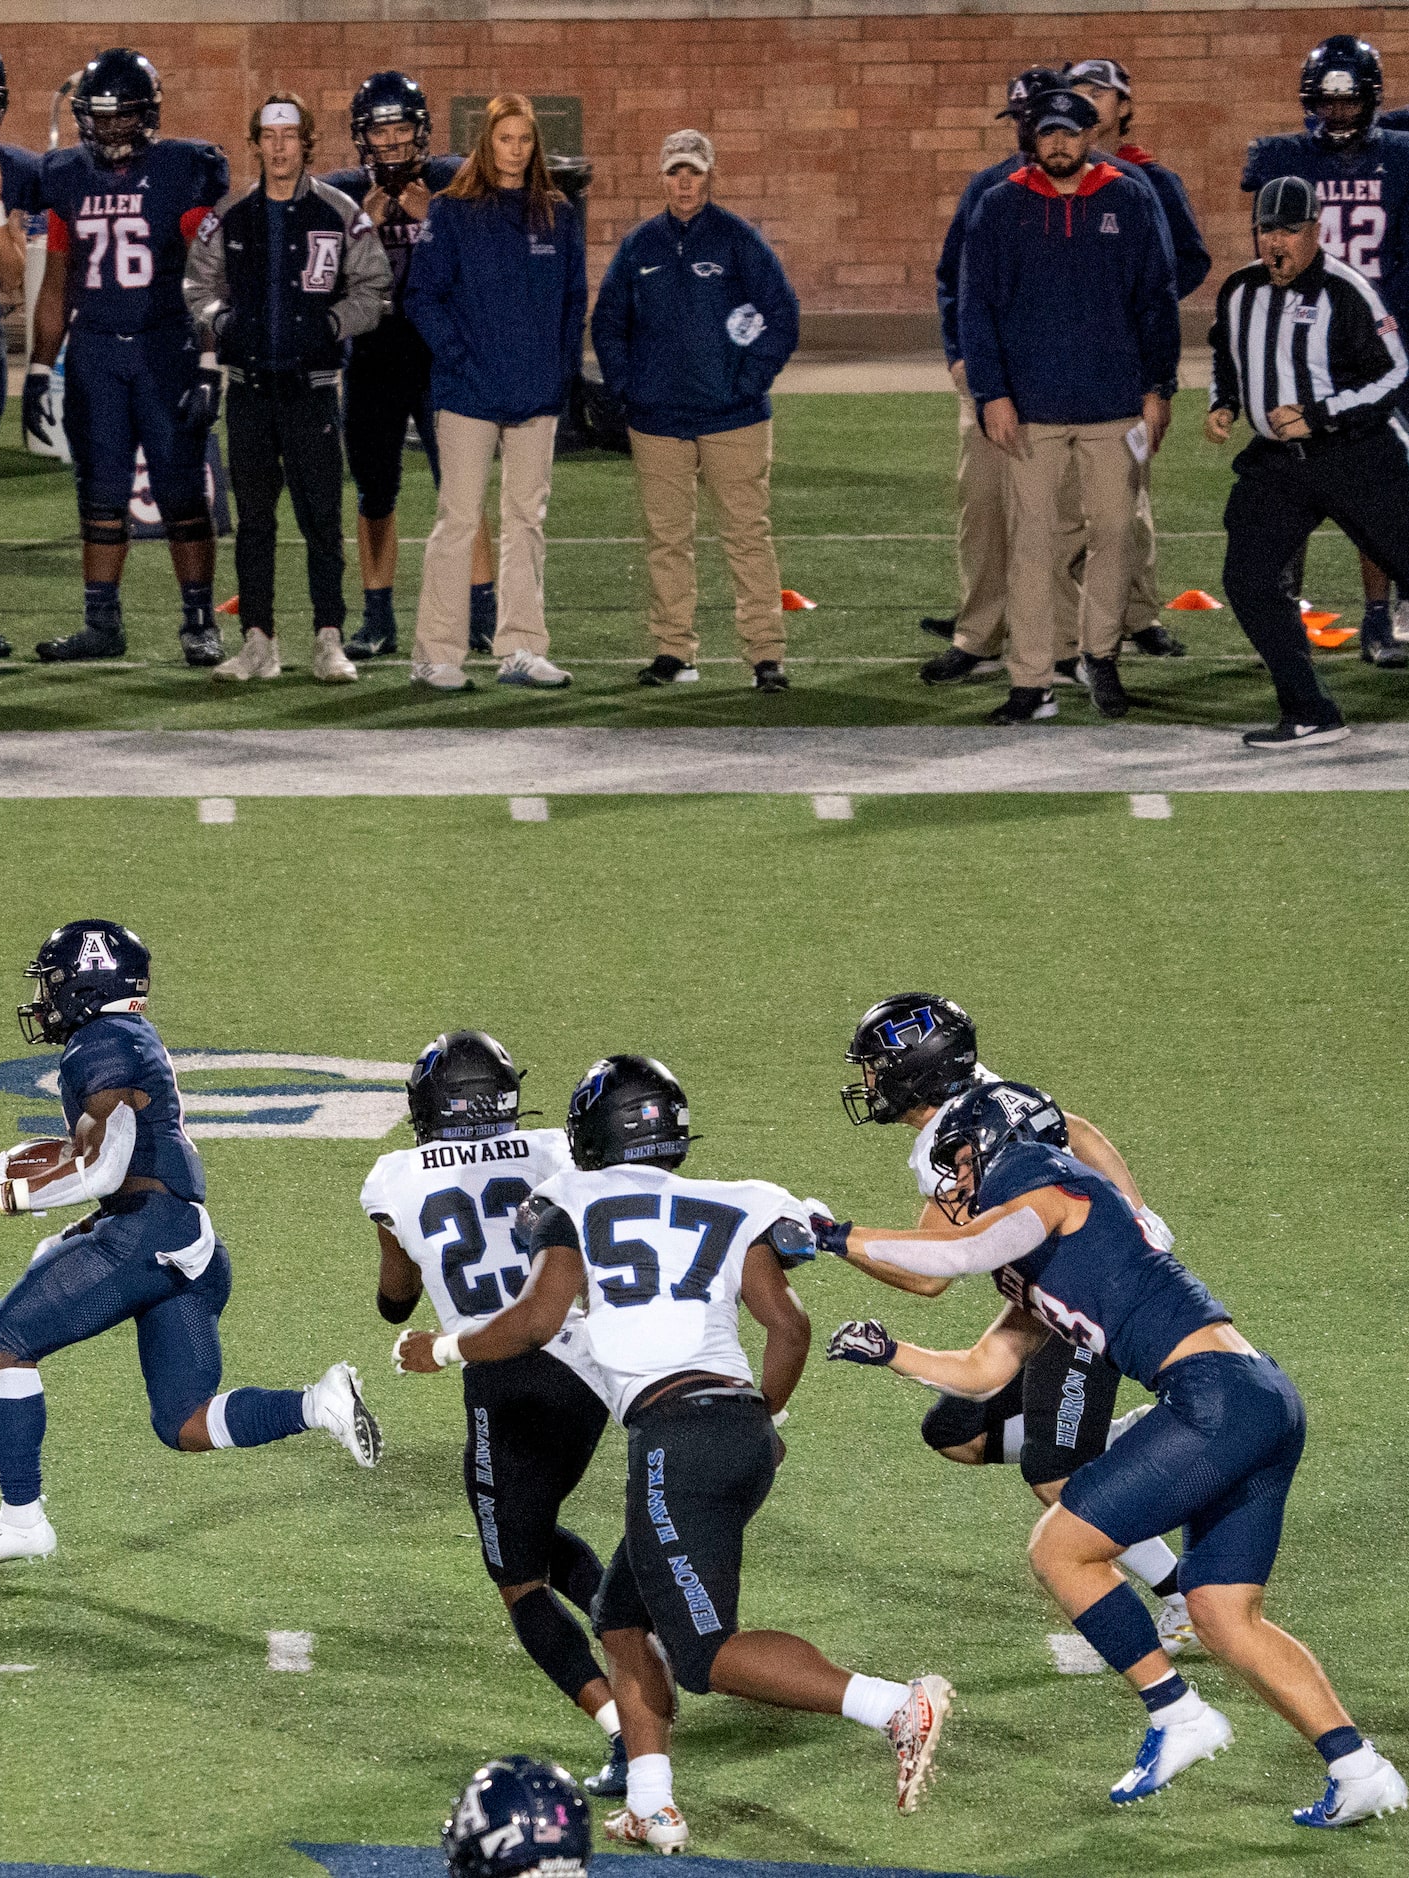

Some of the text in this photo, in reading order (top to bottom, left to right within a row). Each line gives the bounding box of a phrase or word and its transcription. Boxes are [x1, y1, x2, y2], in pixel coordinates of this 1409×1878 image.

[1009, 80, 1029, 100] A
[79, 193, 144, 216] ALLEN
[1315, 179, 1382, 201] ALLEN
[1099, 212, 1120, 234] A
[1318, 205, 1387, 279] 42
[75, 217, 154, 289] 76
[303, 231, 343, 292] A
[76, 930, 118, 972] A
[873, 1005, 937, 1050] H
[988, 1084, 1044, 1128] A
[420, 1140, 530, 1170] HOWARD
[419, 1176, 533, 1317] 23
[583, 1193, 749, 1309] 57
[1056, 1368, 1088, 1449] HEBRON
[474, 1407, 505, 1568] HEBRON HAWKS
[647, 1448, 723, 1637] HEBRON HAWKS
